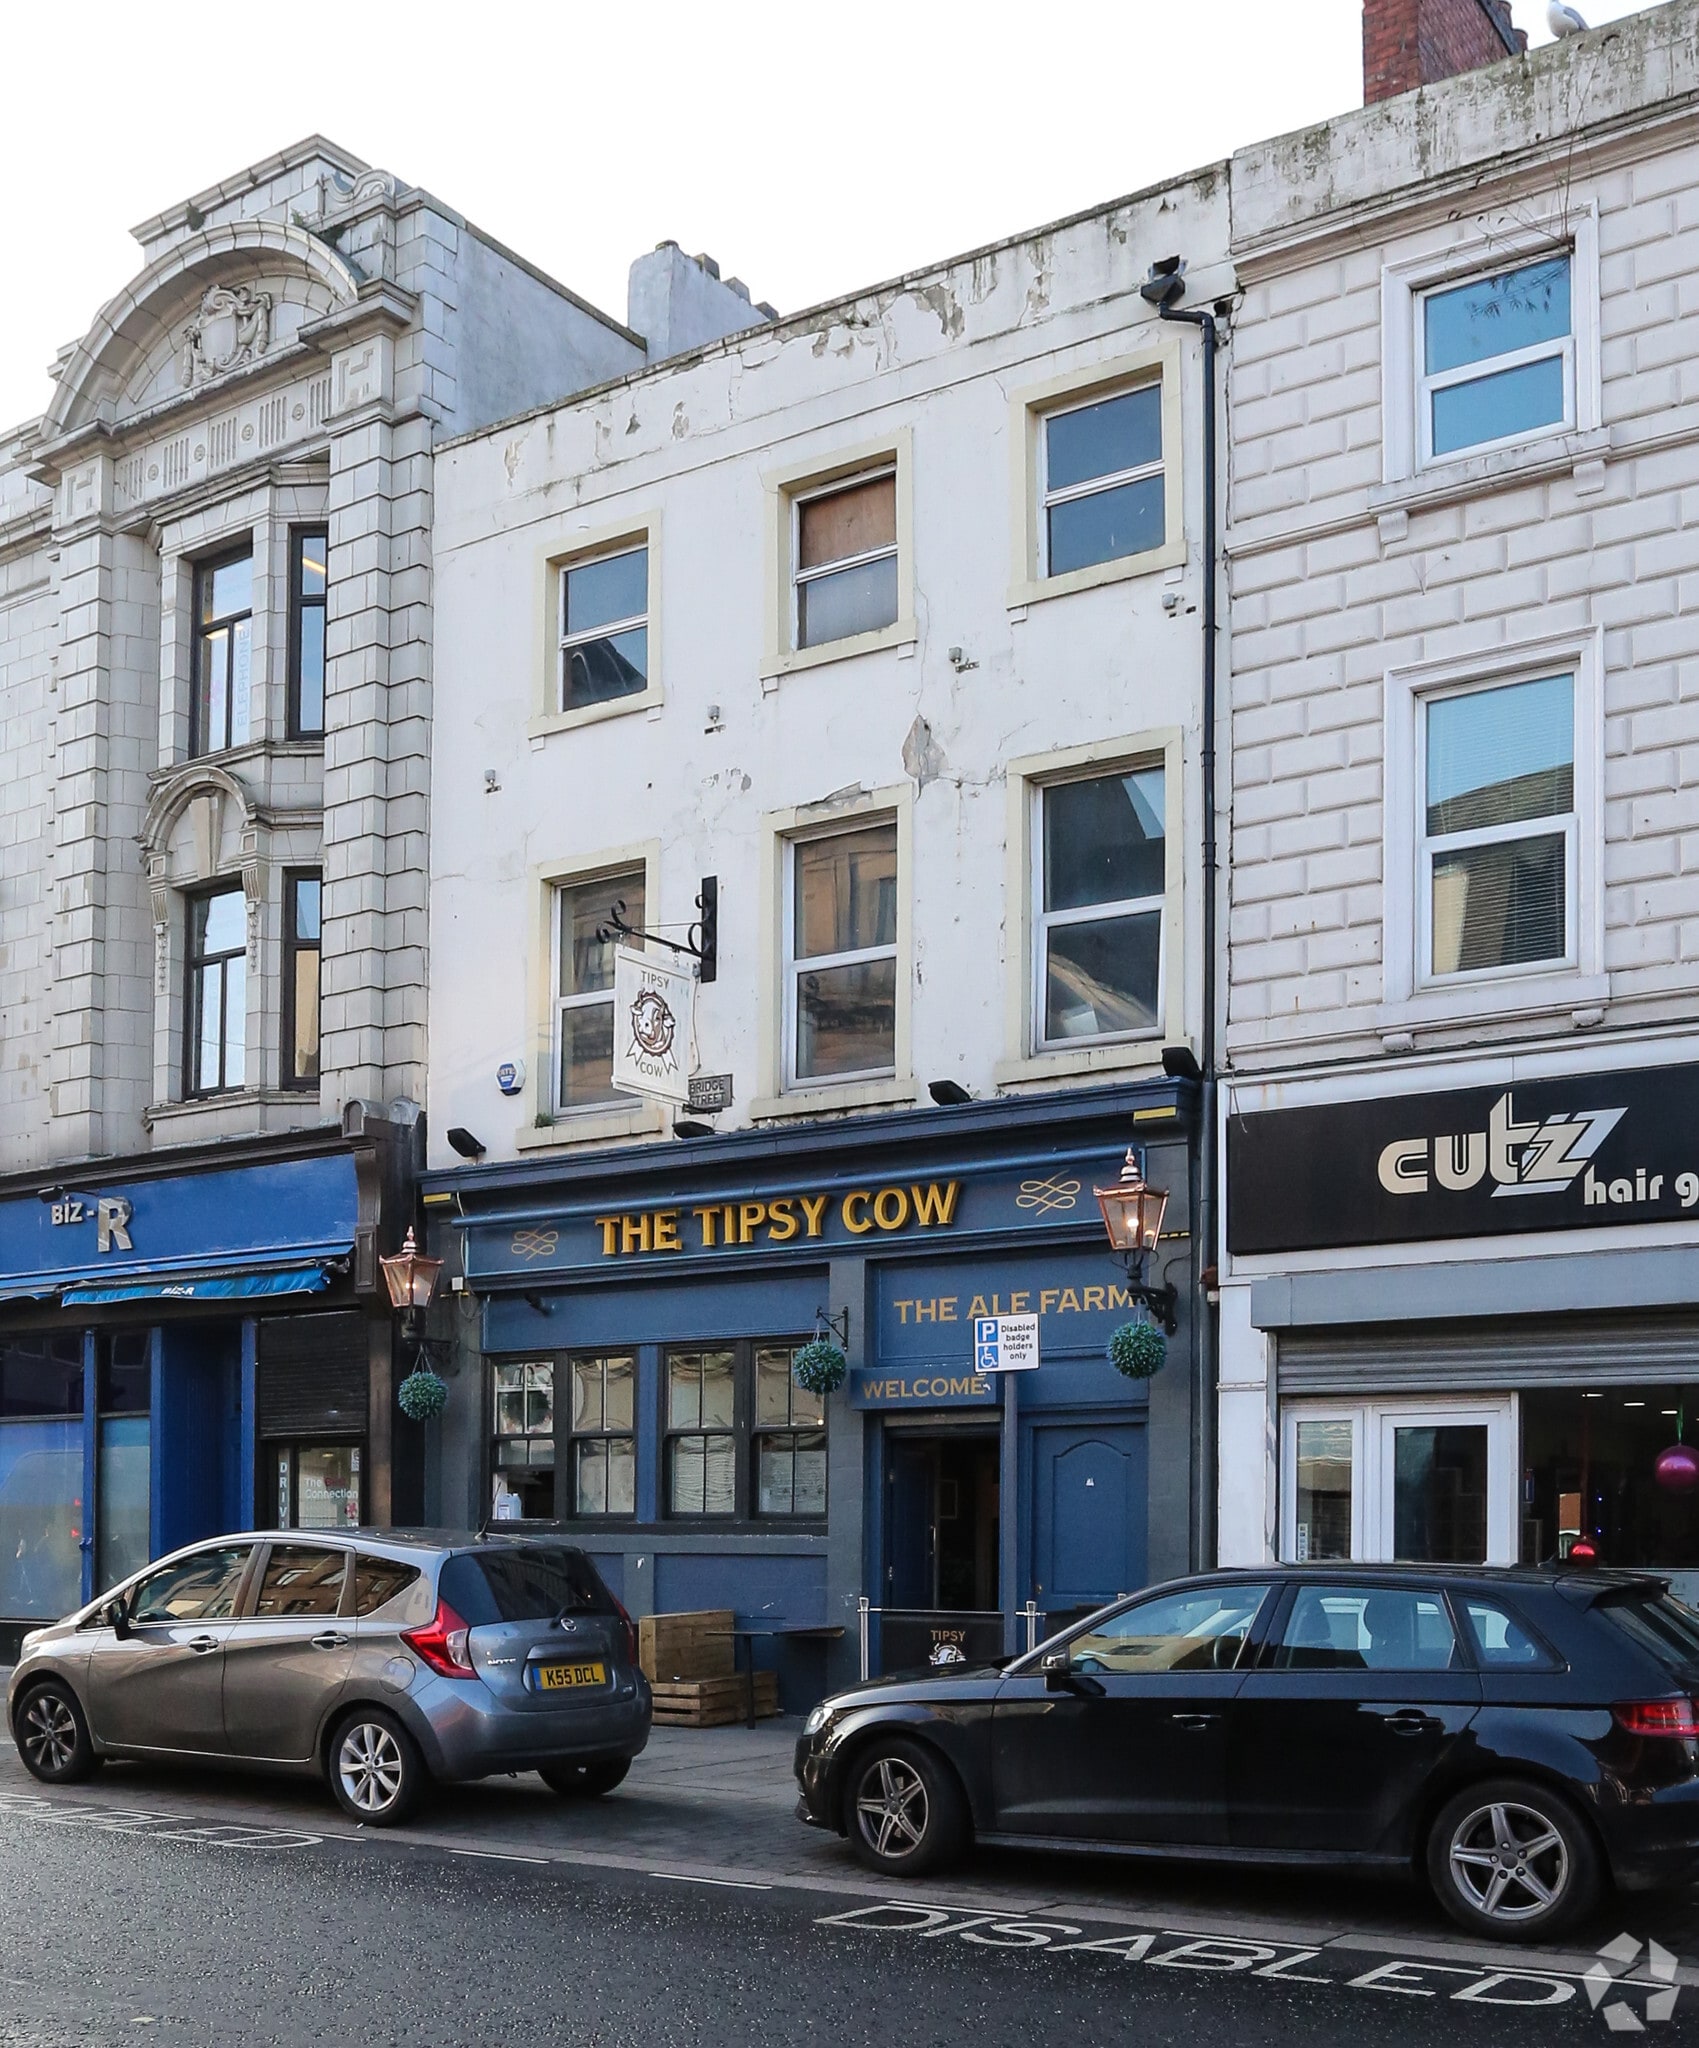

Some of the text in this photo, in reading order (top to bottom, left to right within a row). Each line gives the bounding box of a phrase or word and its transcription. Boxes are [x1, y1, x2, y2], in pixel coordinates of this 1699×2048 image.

[641, 971, 669, 989] TIPSY
[640, 1062, 662, 1077] COW
[690, 1080, 724, 1093] BRIDGE
[690, 1092, 725, 1105] STREET
[1584, 1164, 1663, 1205] hair
[595, 1180, 960, 1255] THE TIPSY COW
[893, 1296, 958, 1324] THE
[966, 1291, 1030, 1320] ALE
[1001, 1323, 1036, 1332] Disabled
[1010, 1352, 1027, 1360] only
[862, 1376, 986, 1399] WELCOME
[305, 1489, 358, 1499] Connection
[930, 1630, 966, 1641] TIPSY
[546, 1667, 600, 1686] K55 DCL
[814, 1905, 1577, 2006] DISABLED
